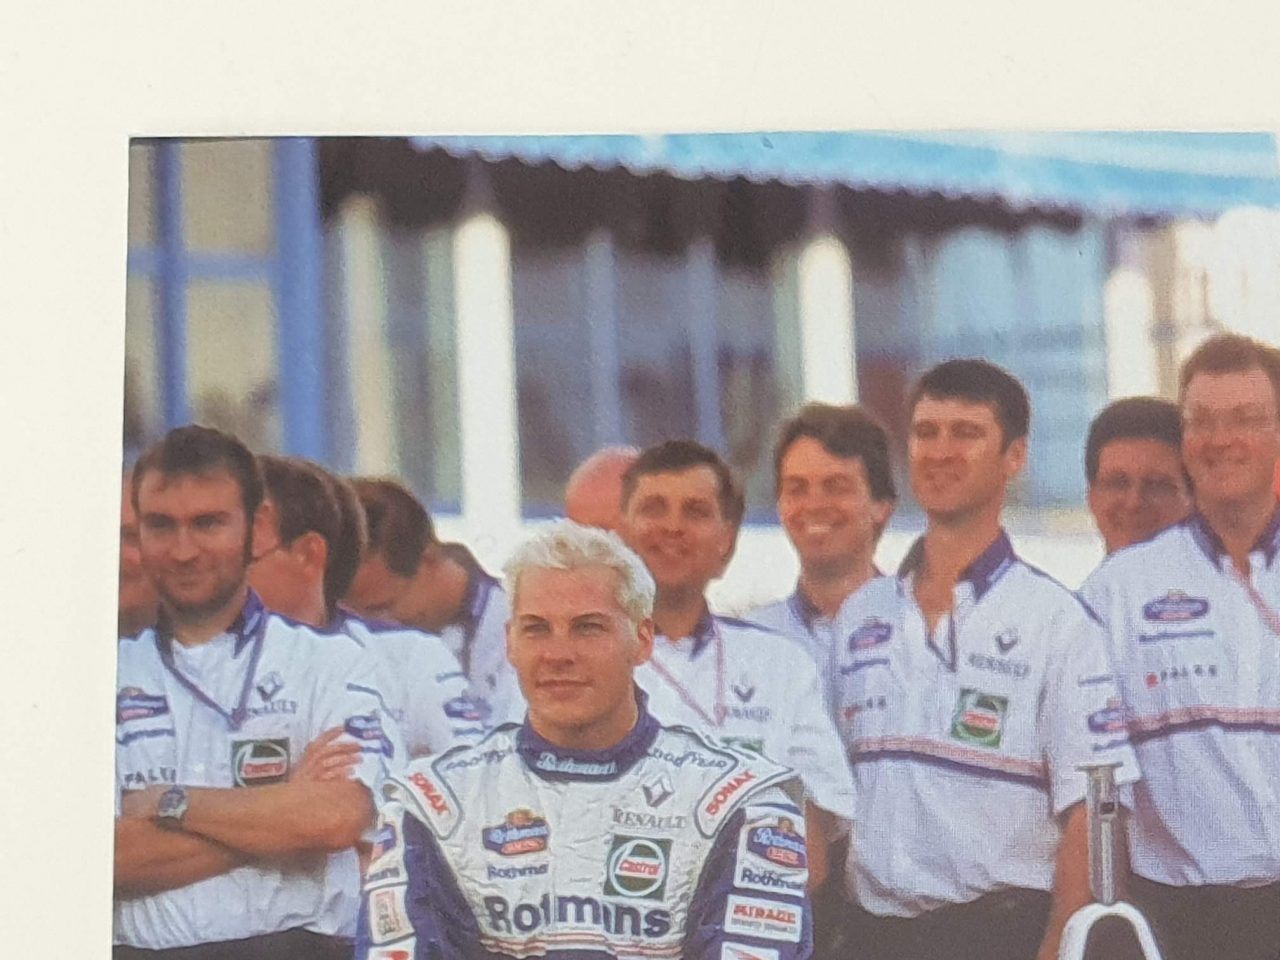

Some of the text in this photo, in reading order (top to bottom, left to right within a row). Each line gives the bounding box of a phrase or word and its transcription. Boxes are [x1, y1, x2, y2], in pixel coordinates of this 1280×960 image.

[705, 770, 757, 816] SONAX
[612, 808, 689, 829] RENAULT
[618, 858, 662, 875] Castrol
[484, 893, 673, 938] Rotmns
